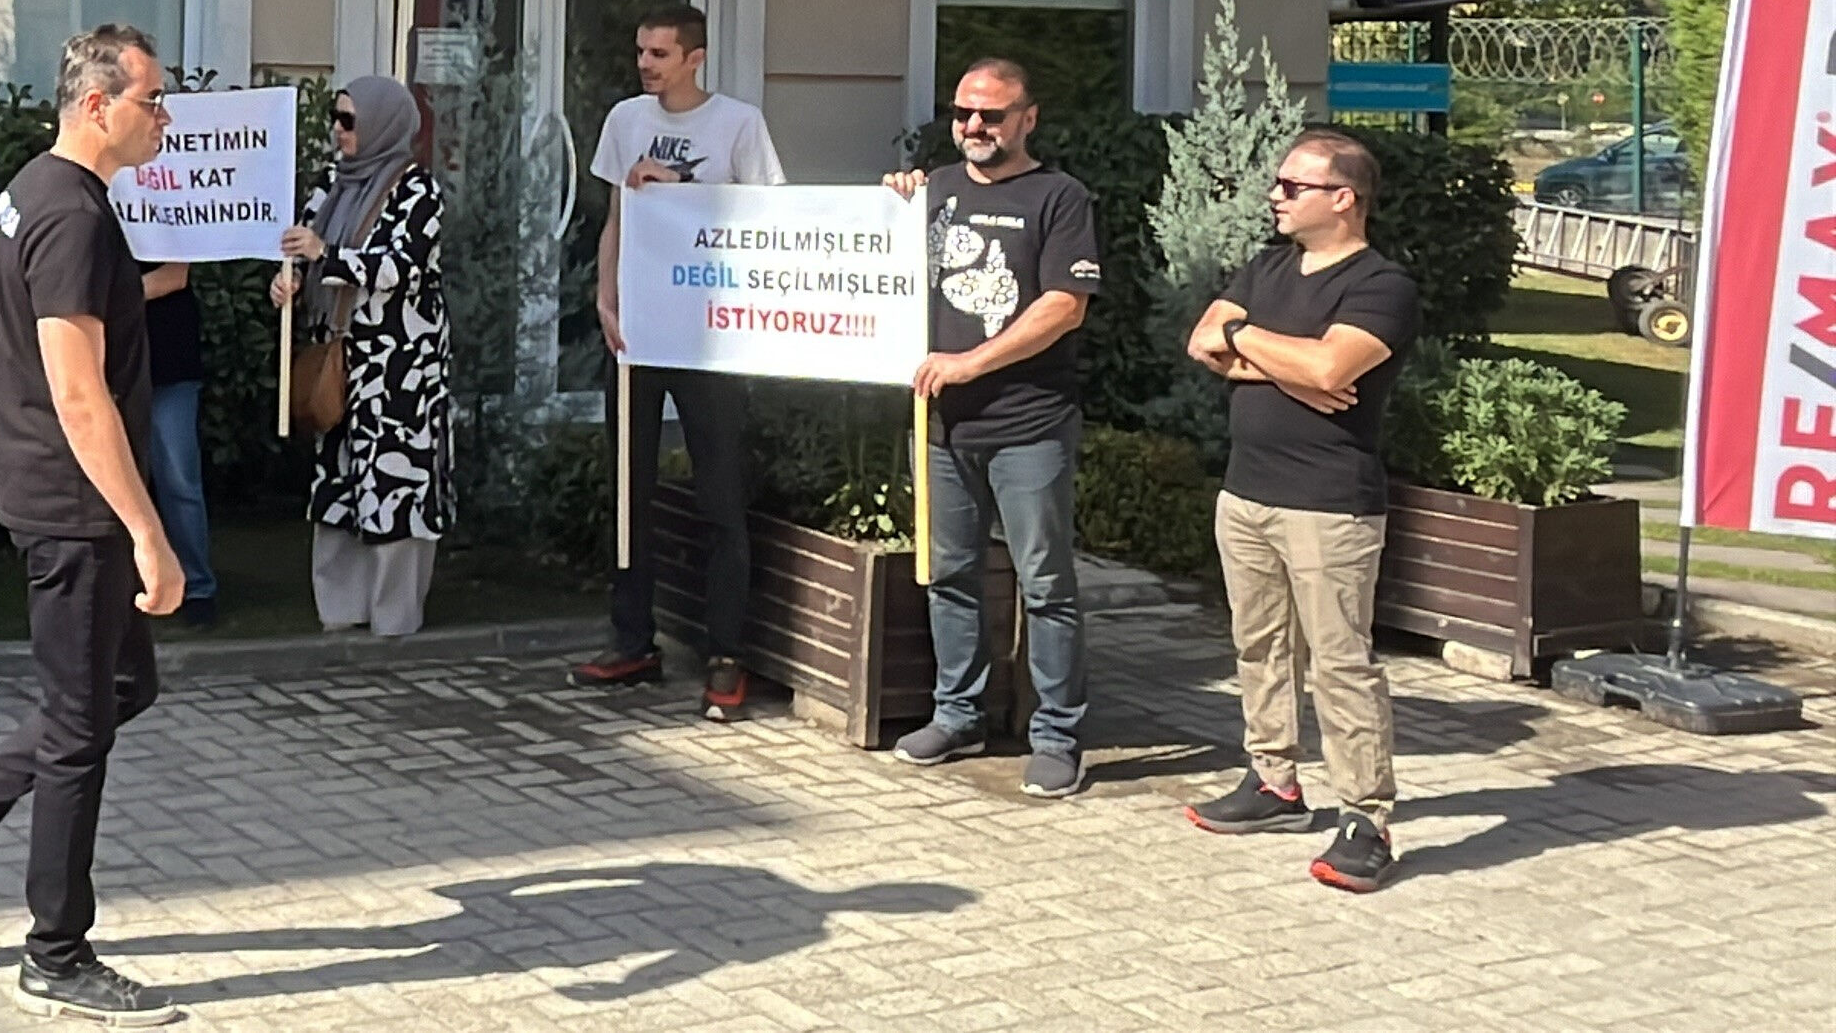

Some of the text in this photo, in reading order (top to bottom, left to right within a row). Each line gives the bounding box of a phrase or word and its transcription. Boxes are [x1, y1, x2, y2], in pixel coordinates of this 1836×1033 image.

[156, 124, 268, 153] NETİMİN
[648, 135, 691, 162] NIKE
[189, 167, 236, 189] KAT
[694, 225, 892, 258] AZLEDİLMİŞLERİ
[672, 261, 915, 300] DEĞİL SEÇİLMİŞLERİ
[707, 300, 876, 338] İSTİYORUZ!!!!
